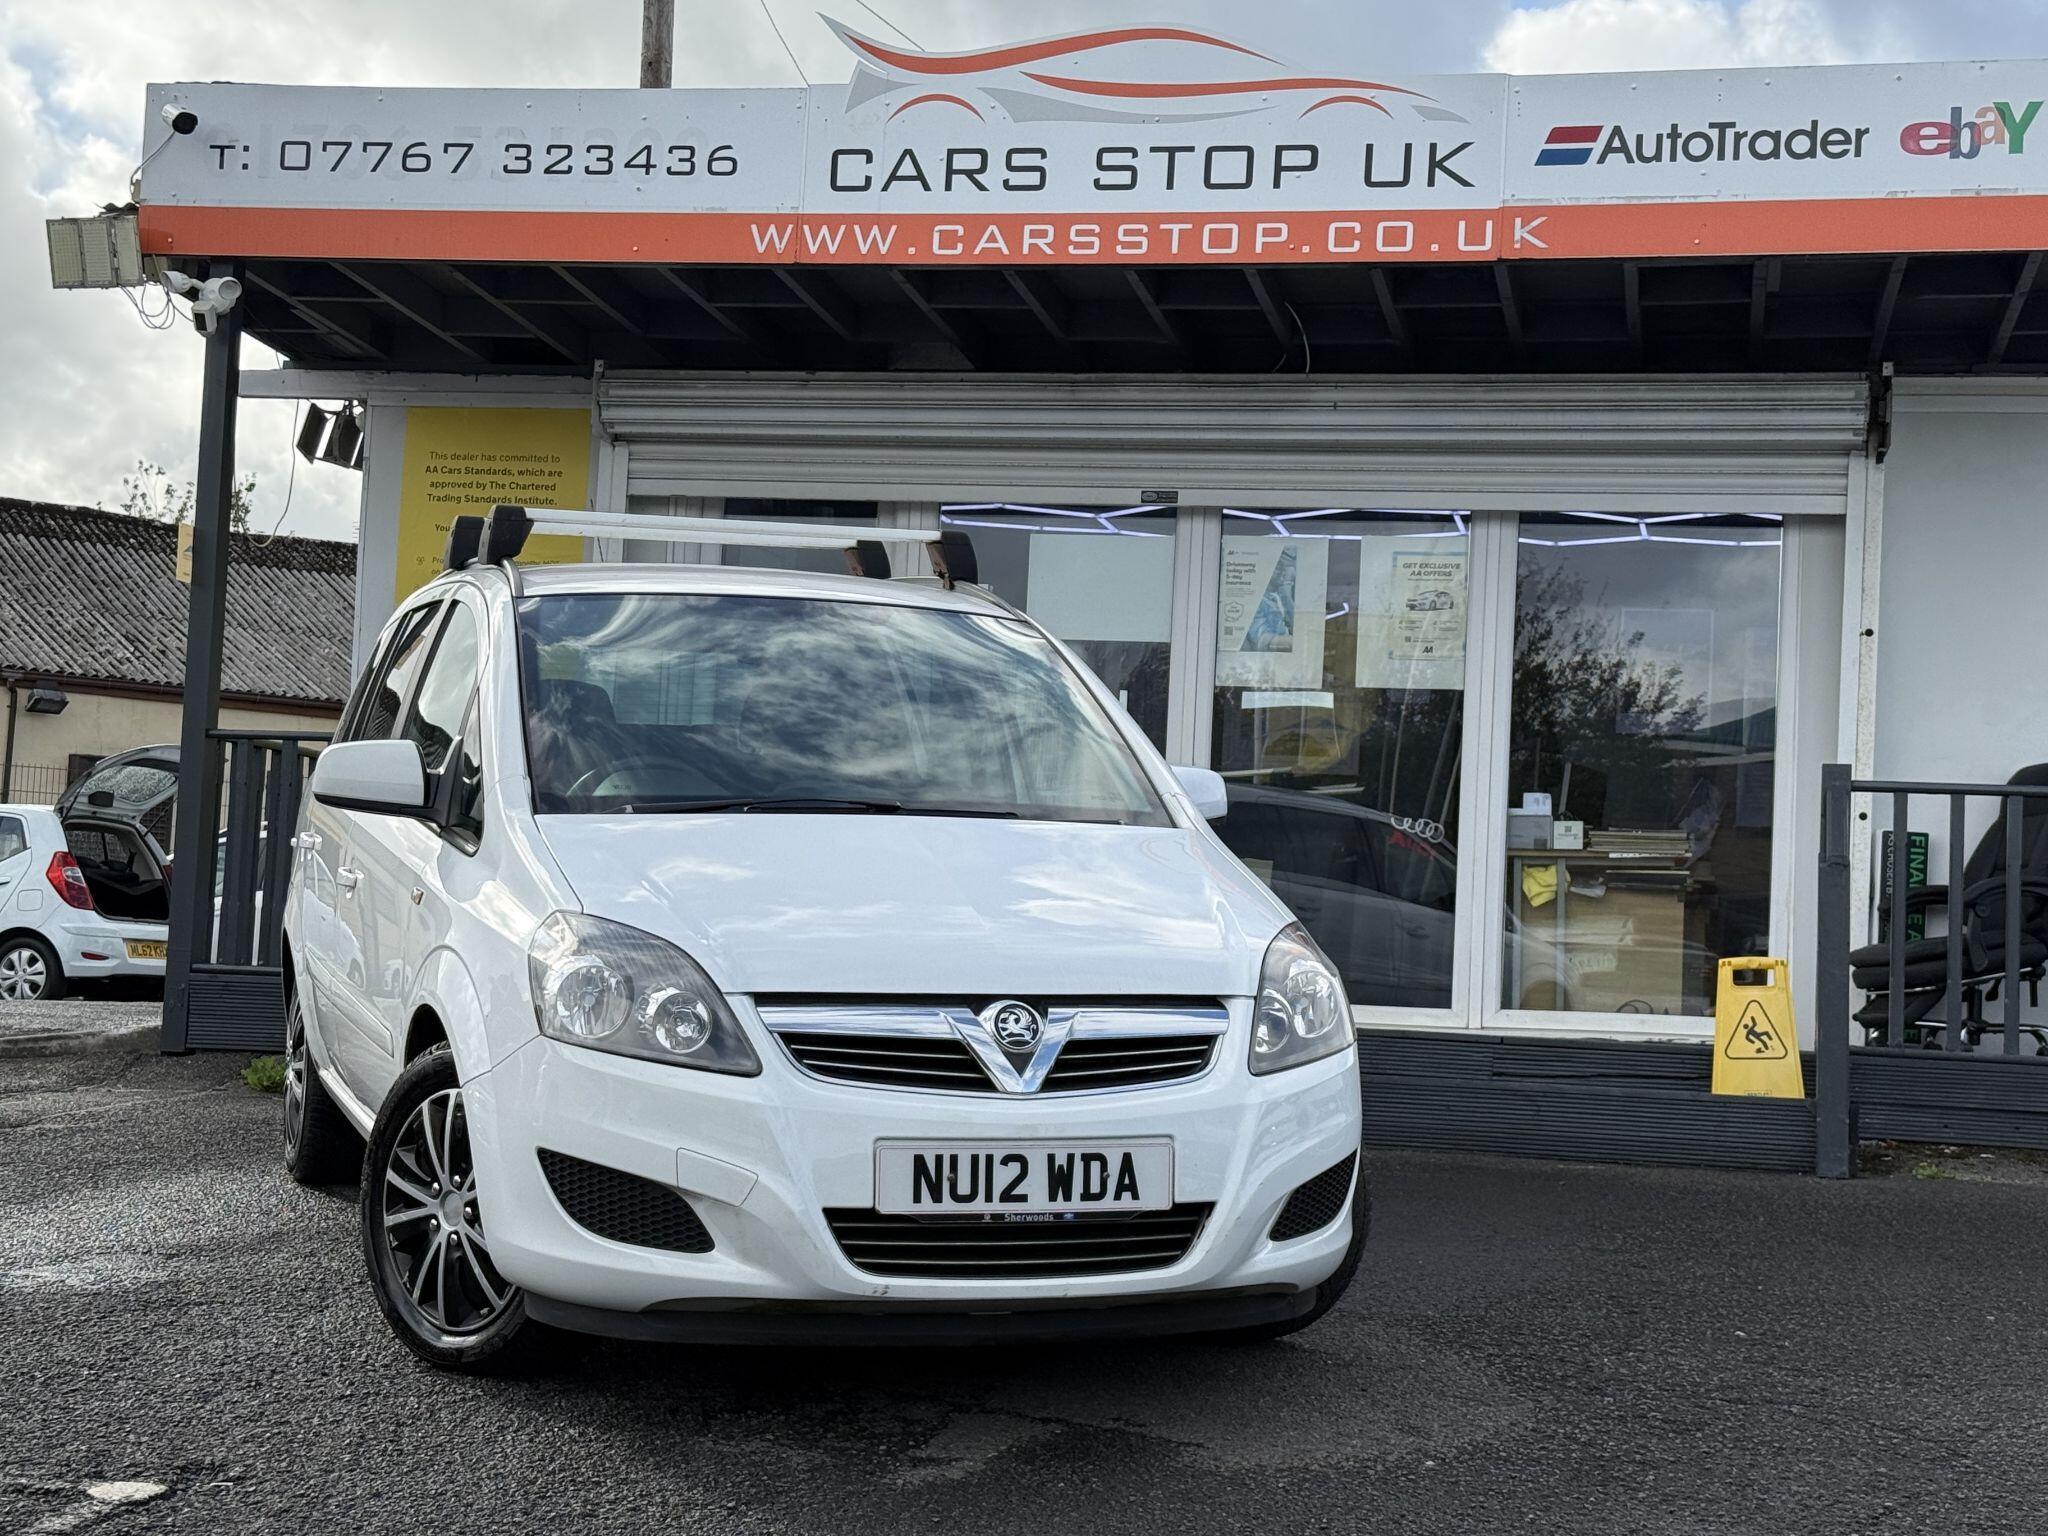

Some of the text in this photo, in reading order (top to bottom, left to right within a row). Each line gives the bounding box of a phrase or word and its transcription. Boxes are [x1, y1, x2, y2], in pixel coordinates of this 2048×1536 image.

[1596, 119, 1870, 165] AutoTrader
[209, 140, 739, 177] T: 07767 323436
[830, 141, 1476, 193] CARS STOP UK
[429, 451, 560, 464] This dealer has committed to
[425, 466, 439, 474] AA
[441, 466, 462, 475] Cars
[464, 467, 515, 477] Standards,
[517, 468, 546, 477] which
[429, 481, 557, 491] approved by The Chartered
[427, 493, 558, 506] Trading Standards Institute.
[1418, 562, 1461, 570] EXCLUSIVE
[912, 1152, 1141, 1204] NU12 WDA
[1004, 1212, 1054, 1221] Sherwoods
